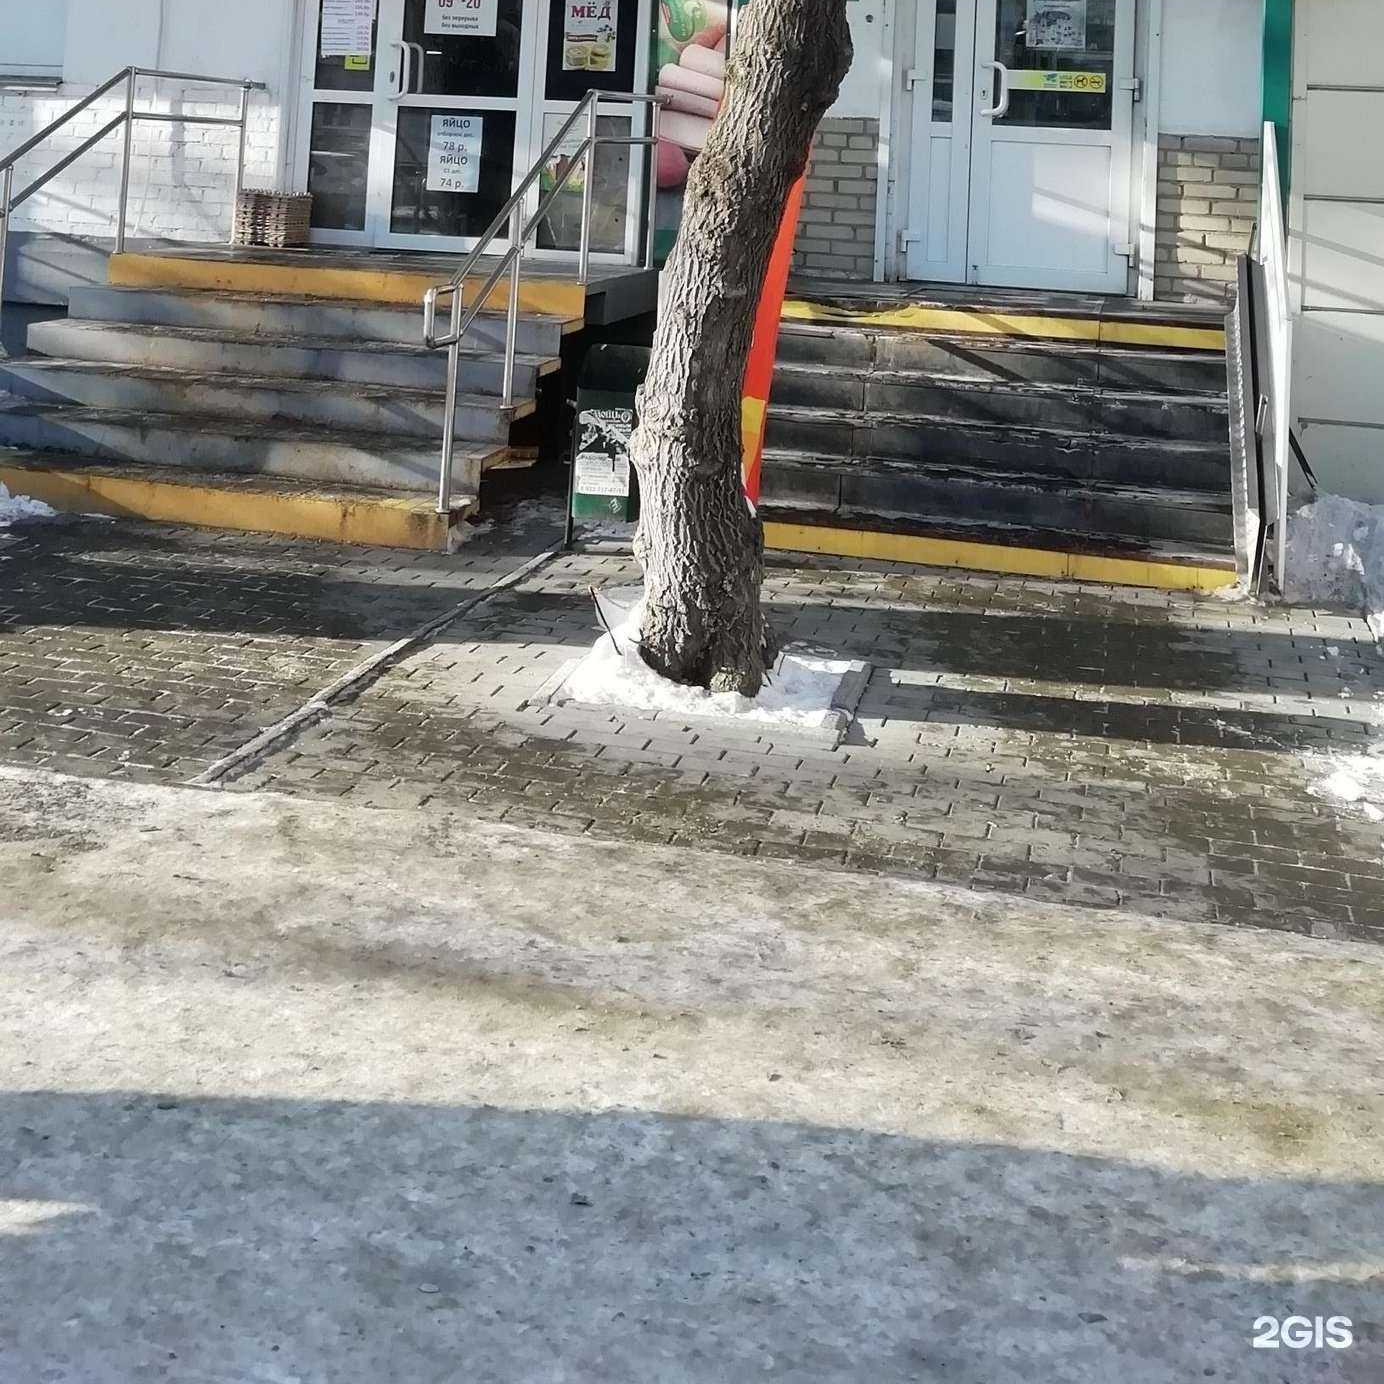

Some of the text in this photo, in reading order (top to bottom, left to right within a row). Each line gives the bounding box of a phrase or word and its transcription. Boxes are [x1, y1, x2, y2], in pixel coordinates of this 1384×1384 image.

[571, 1, 612, 21] МЁД
[442, 118, 471, 130] ЯЙЦО
[440, 153, 468, 166] ЯЙЦО
